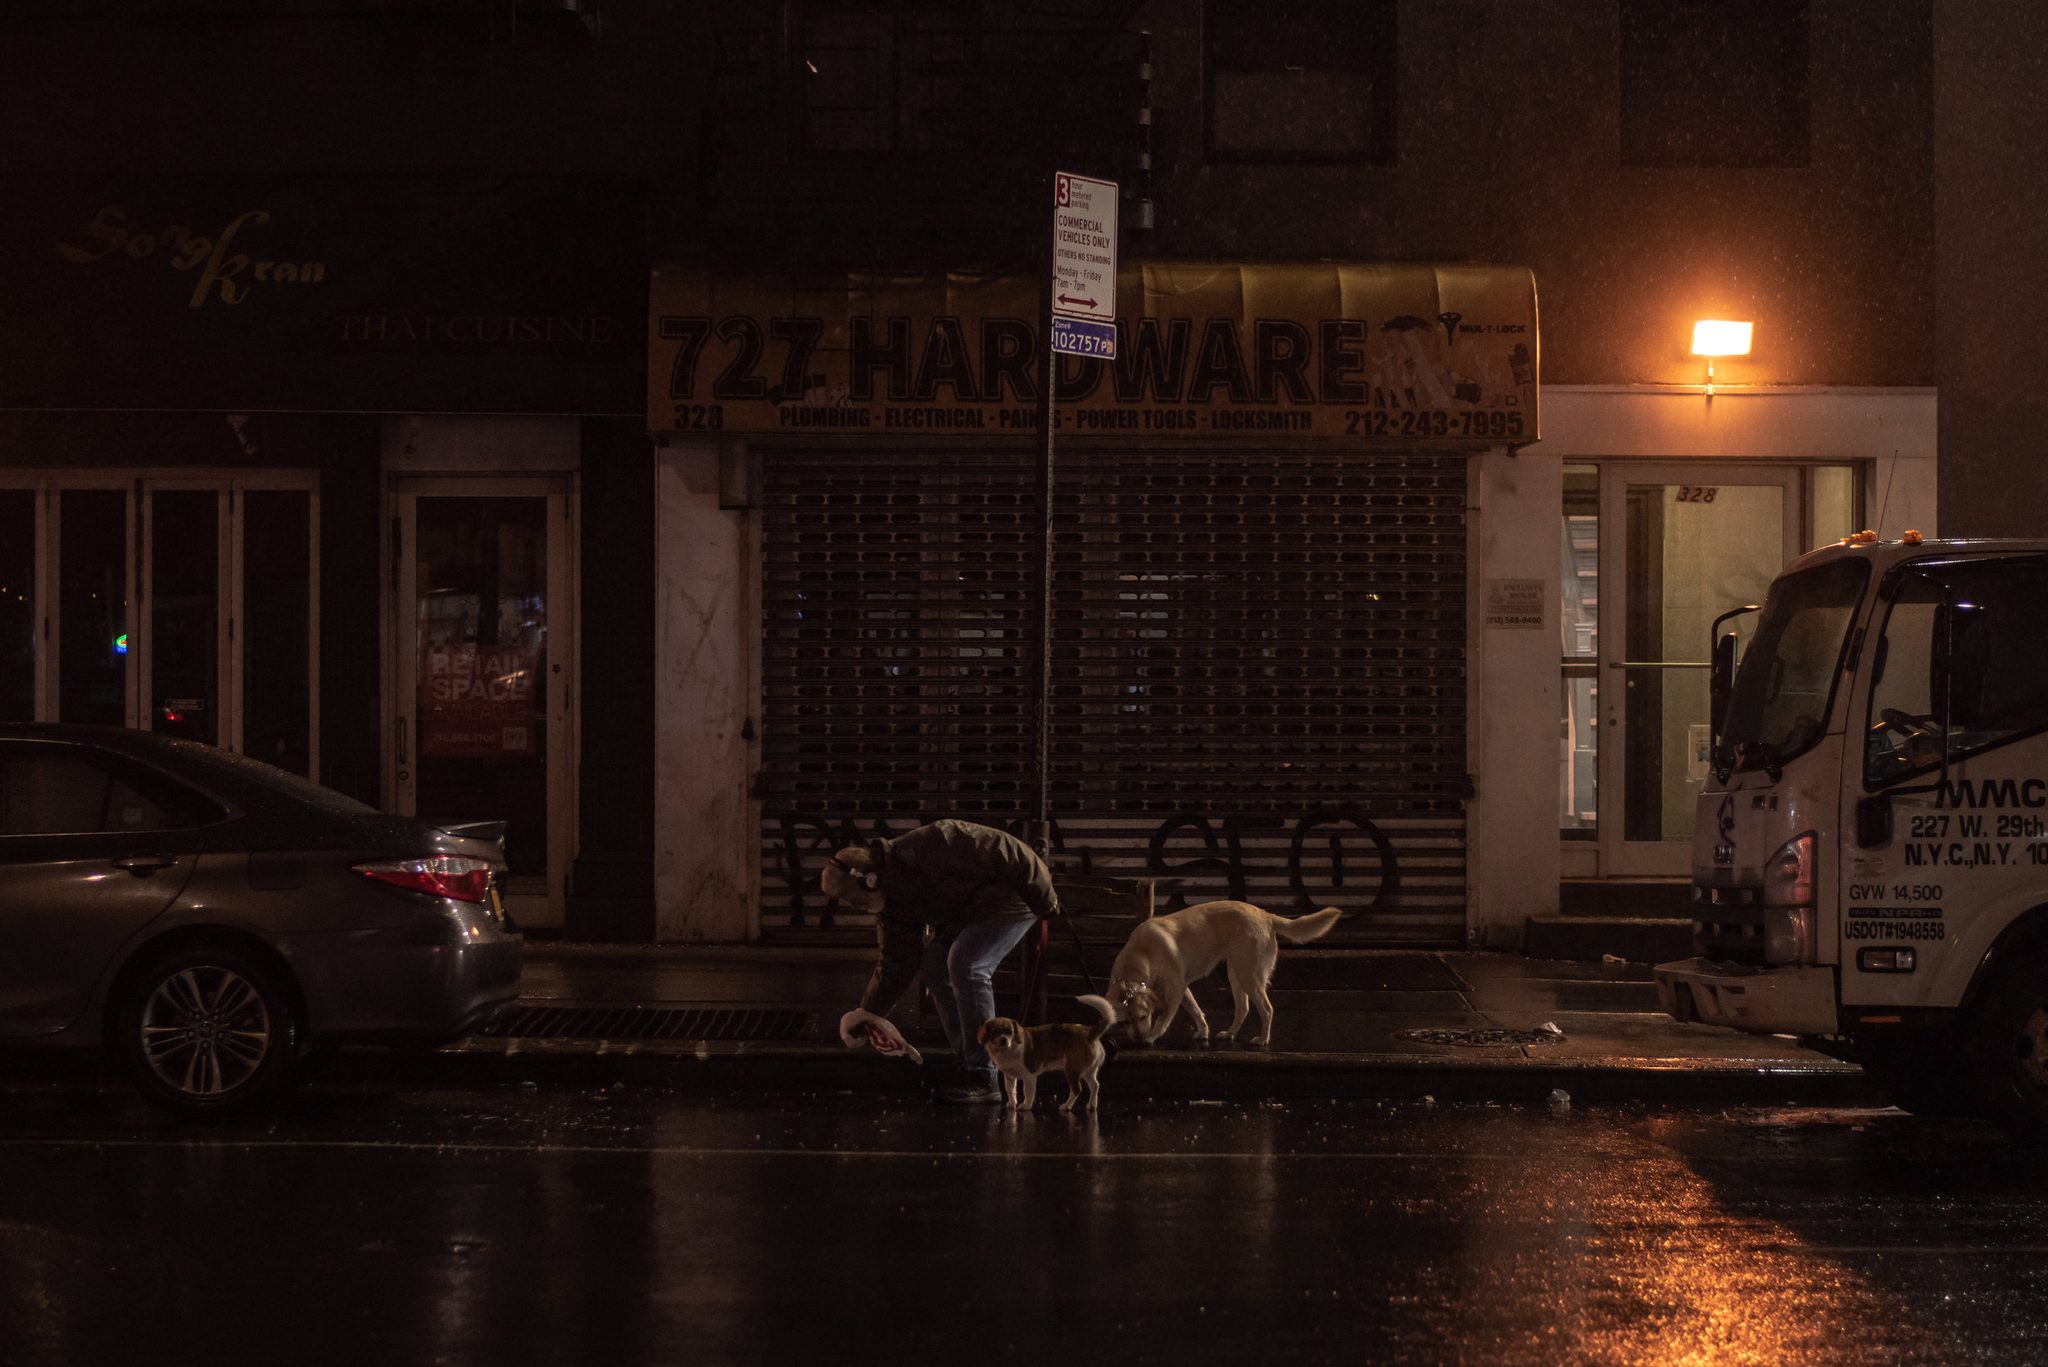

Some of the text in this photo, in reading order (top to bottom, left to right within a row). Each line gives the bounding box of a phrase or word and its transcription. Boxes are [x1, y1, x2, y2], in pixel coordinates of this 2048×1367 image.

[1058, 178, 1069, 205] 3
[1058, 214, 1103, 233] COMMERCIAL
[1058, 230, 1111, 249] VEHICLES ONLY
[1057, 248, 1077, 259] OTHERS
[1086, 254, 1111, 265] STANDING
[1057, 265, 1102, 283] Monday Friday
[1057, 277, 1086, 292] 7am 7pm
[336, 314, 610, 343] THAI CUISINE
[1055, 331, 1100, 352] 102757
[659, 315, 823, 400] 727
[674, 405, 723, 430] 328
[780, 406, 1312, 431] PLUMBING ELECTRICAL PAINS POWER TOOLS LOCKSMITH
[1678, 486, 1717, 503] 328
[432, 653, 523, 676] RETAIL
[432, 677, 528, 701] SPACE
[1911, 815, 2044, 838] 227 W. 29th
[1849, 884, 1943, 903] GVW 14,500
[1844, 920, 1945, 940] USDOT#1948558
